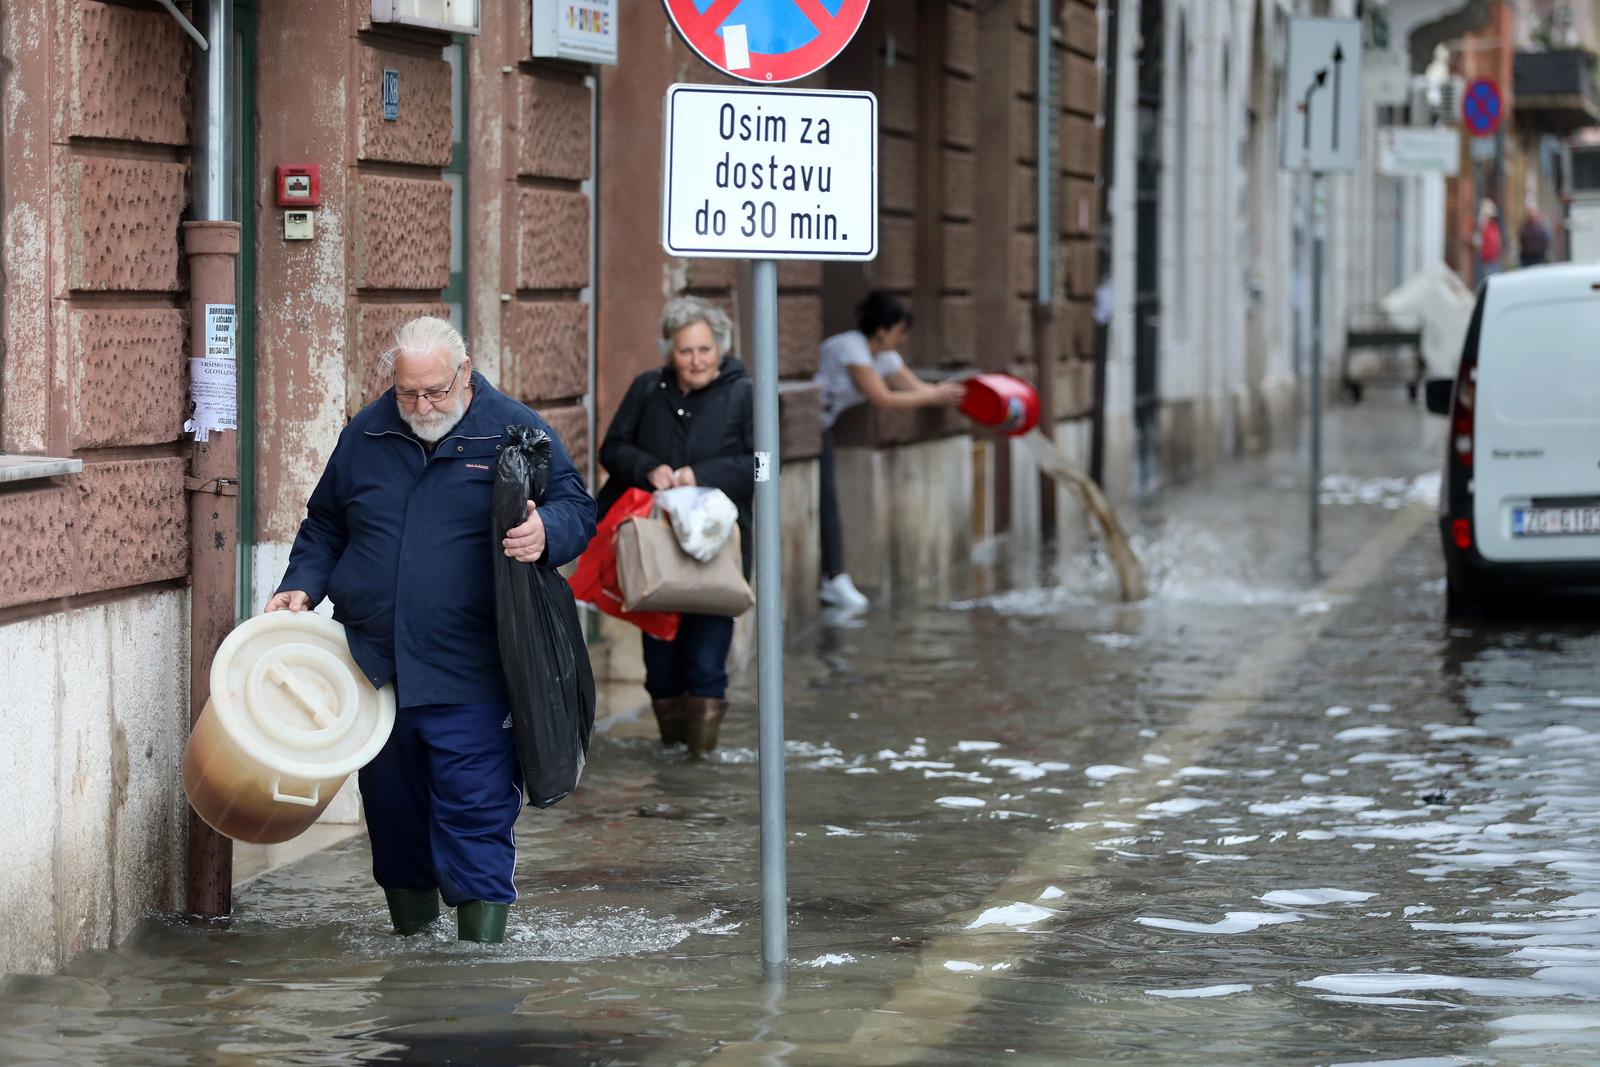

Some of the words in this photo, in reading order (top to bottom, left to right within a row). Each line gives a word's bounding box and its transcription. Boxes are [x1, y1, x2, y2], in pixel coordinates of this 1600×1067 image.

[719, 102, 786, 143] Osim
[800, 117, 831, 145] za
[716, 151, 832, 193] dostavu
[695, 199, 726, 236] do
[741, 200, 776, 239] 30
[790, 205, 849, 241] min.
